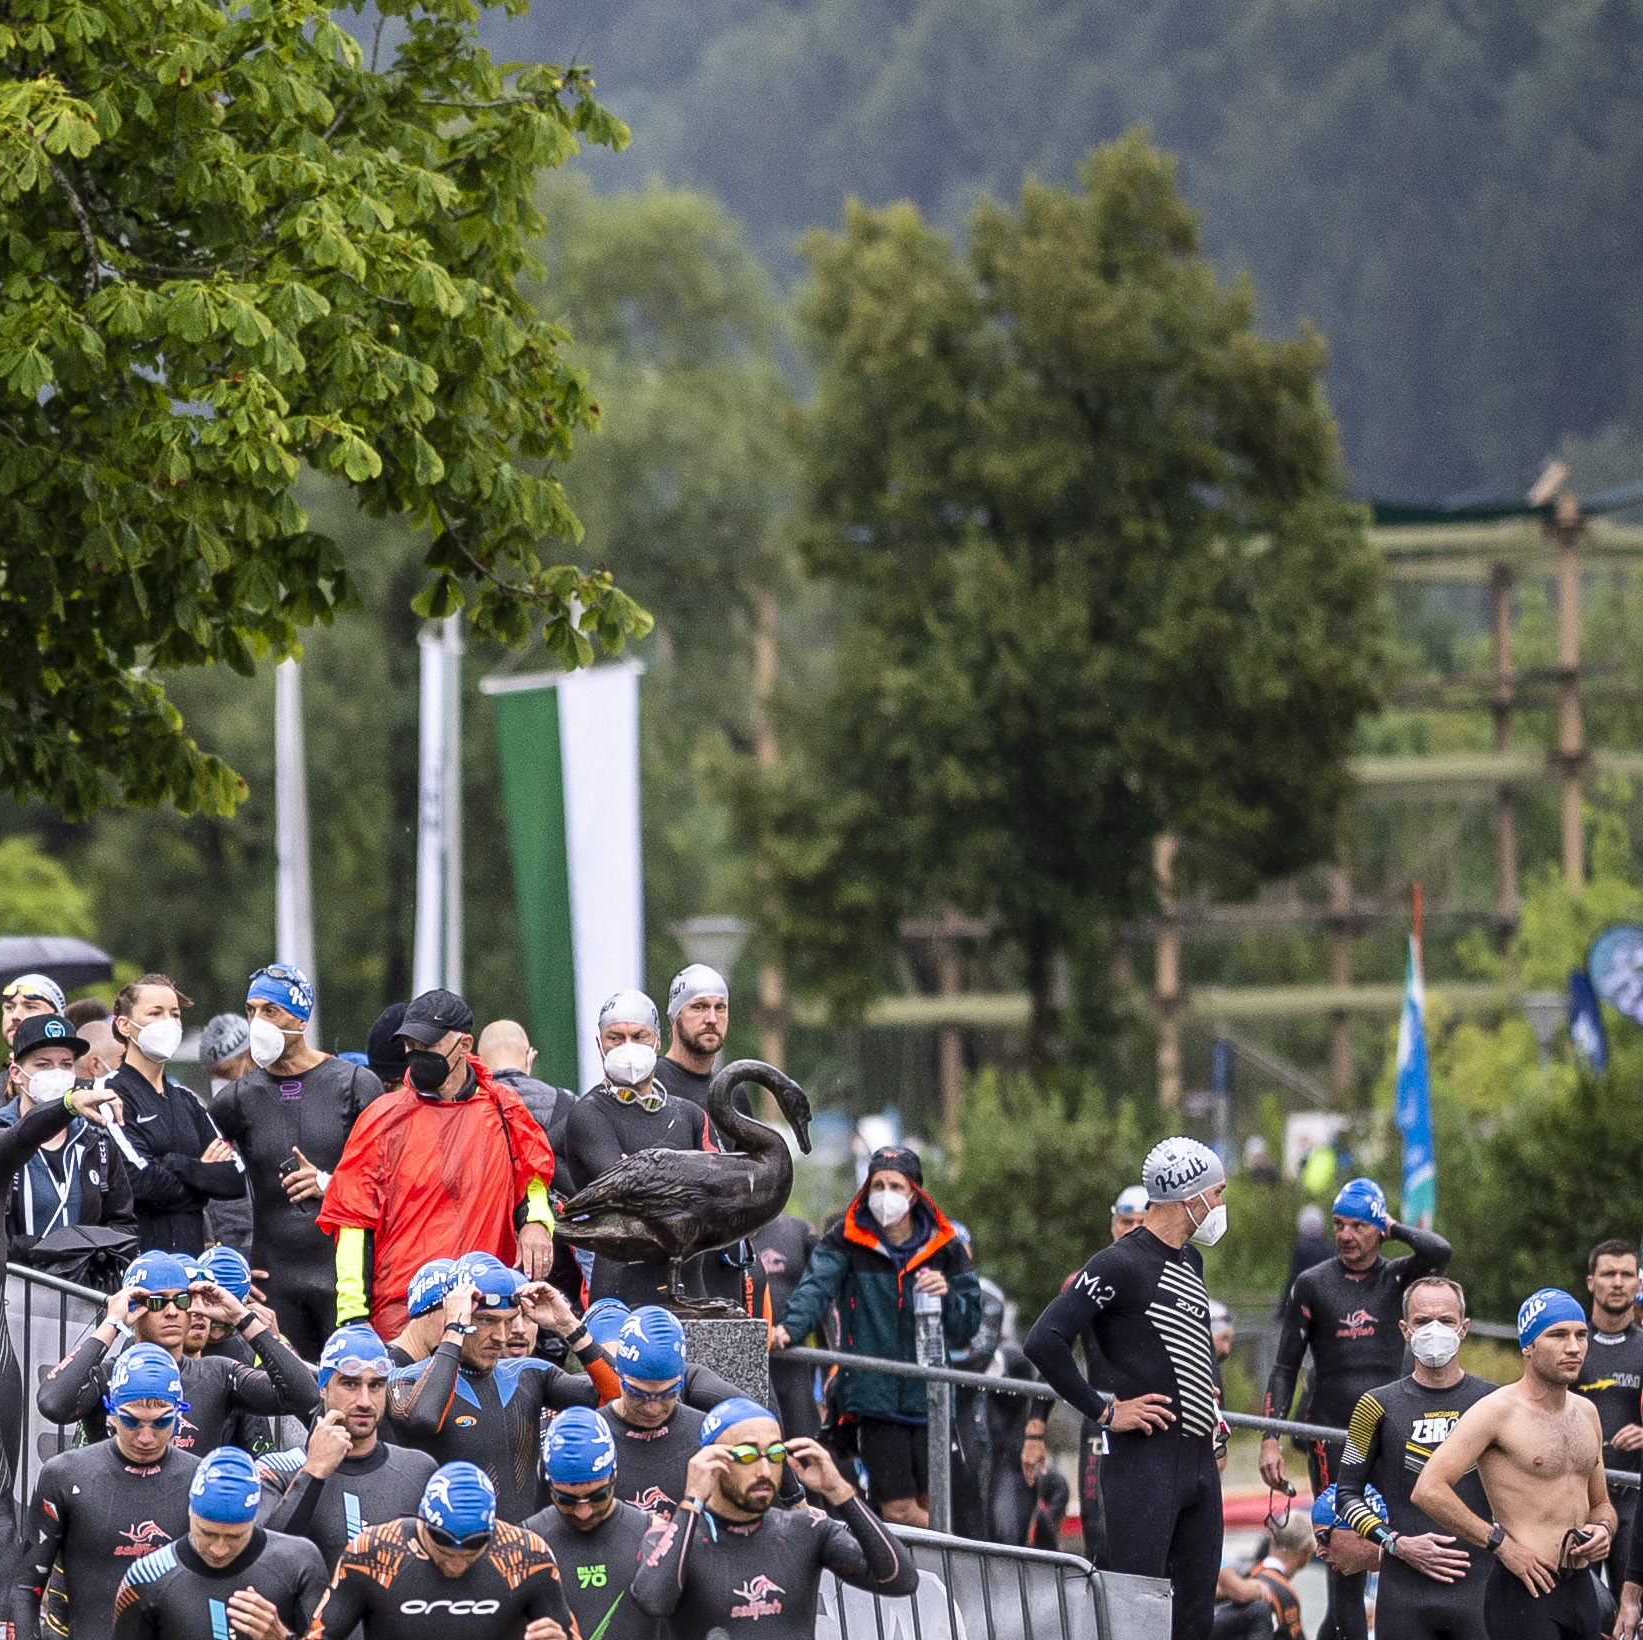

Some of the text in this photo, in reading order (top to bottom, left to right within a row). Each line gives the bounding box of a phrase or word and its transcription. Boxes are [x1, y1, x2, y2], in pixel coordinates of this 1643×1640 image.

[1155, 1158, 1209, 1193] Kult
[1176, 1299, 1206, 1317] 2XU
[577, 1565, 606, 1574] BLUE
[578, 1573, 606, 1588] 70
[401, 1601, 499, 1614] orca
